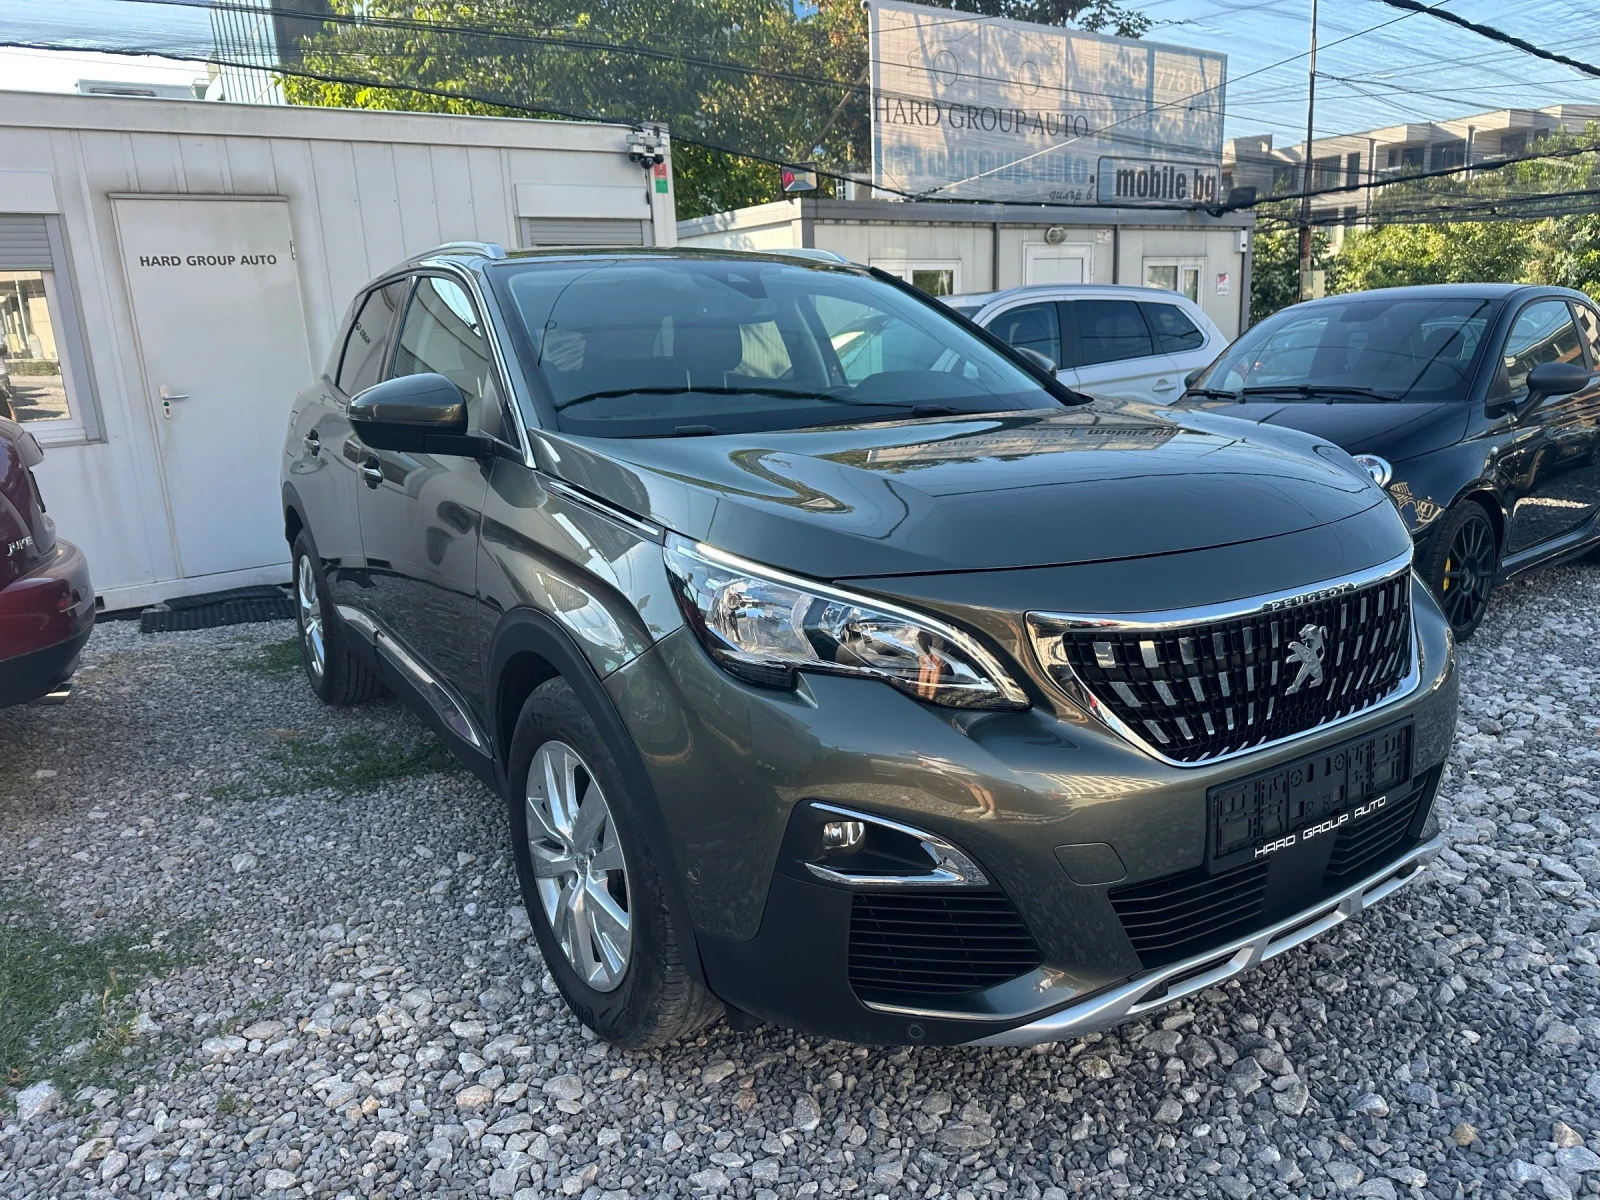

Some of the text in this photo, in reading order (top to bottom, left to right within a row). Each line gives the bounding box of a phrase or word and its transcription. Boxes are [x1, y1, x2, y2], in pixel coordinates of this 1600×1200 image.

[873, 96, 1088, 137] HARD GROUP AUTO
[1116, 165, 1187, 199] mobile
[139, 254, 277, 267] HARD GROUP AUTO
[1271, 583, 1349, 611] PEUGEOT
[1254, 795, 1386, 858] HARD GROUP AUTO
